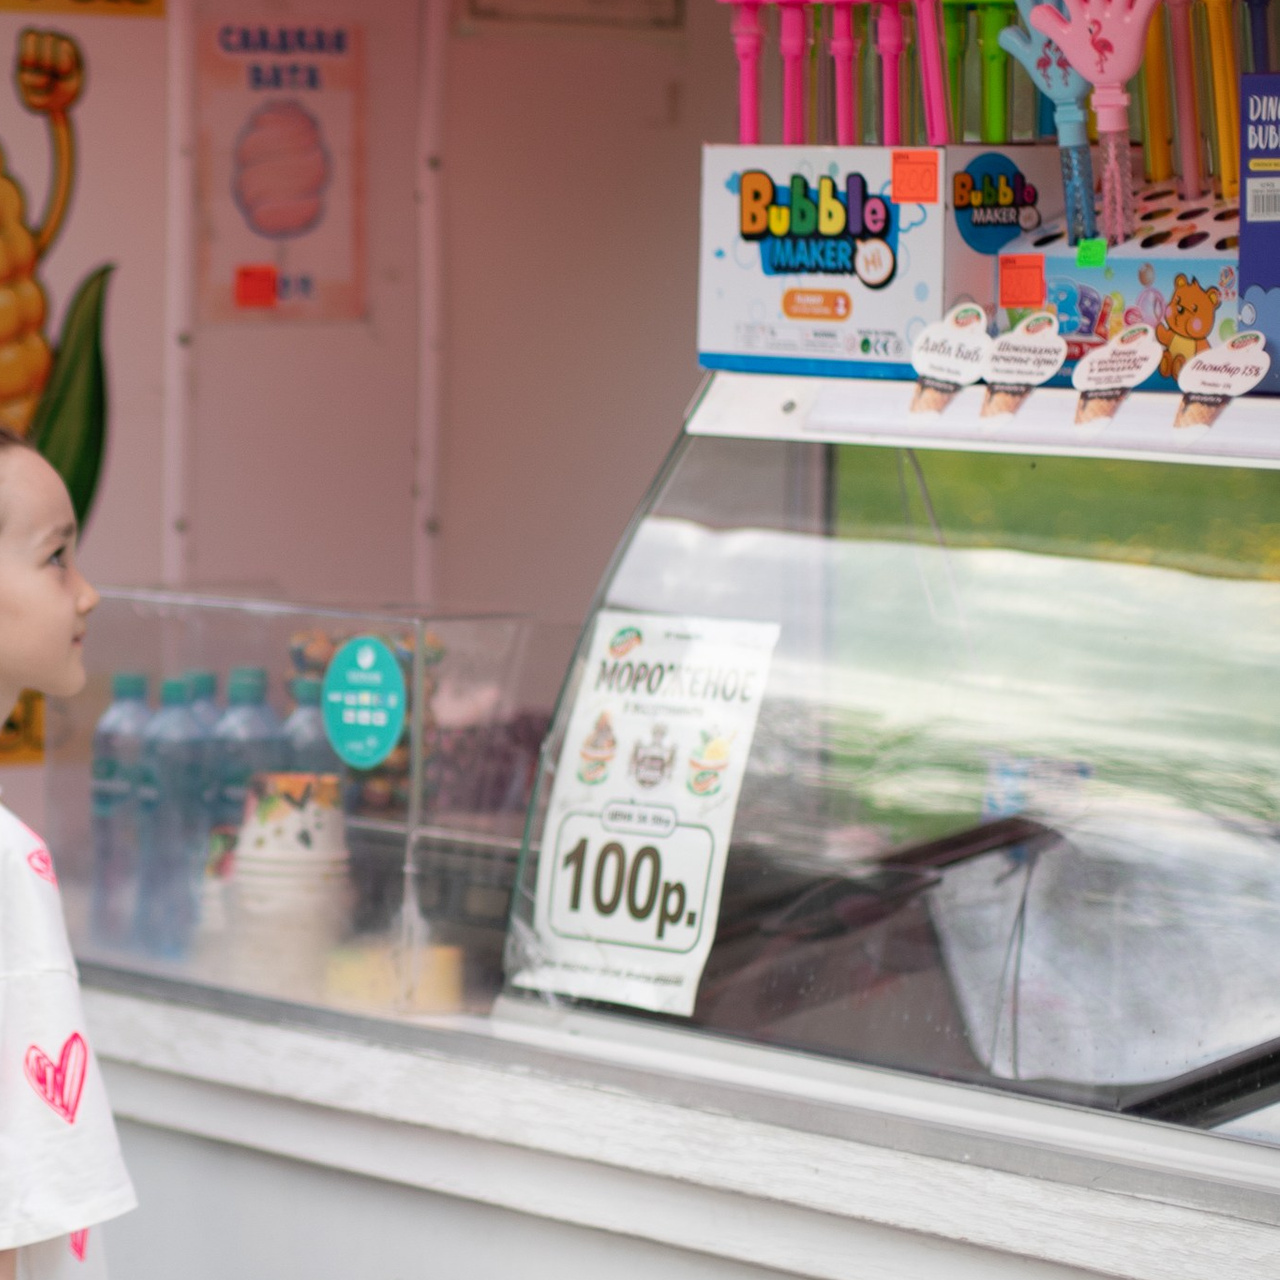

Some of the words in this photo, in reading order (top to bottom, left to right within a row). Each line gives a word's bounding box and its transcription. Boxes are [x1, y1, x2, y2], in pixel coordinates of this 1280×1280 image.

[1247, 124, 1280, 151] BUB
[740, 169, 888, 241] Bubble
[953, 171, 1038, 210] Bubble
[972, 206, 1018, 225] MAKER
[772, 237, 855, 274] MAKER
[1190, 356, 1242, 378] Пломбир
[562, 837, 697, 941] 100р.
